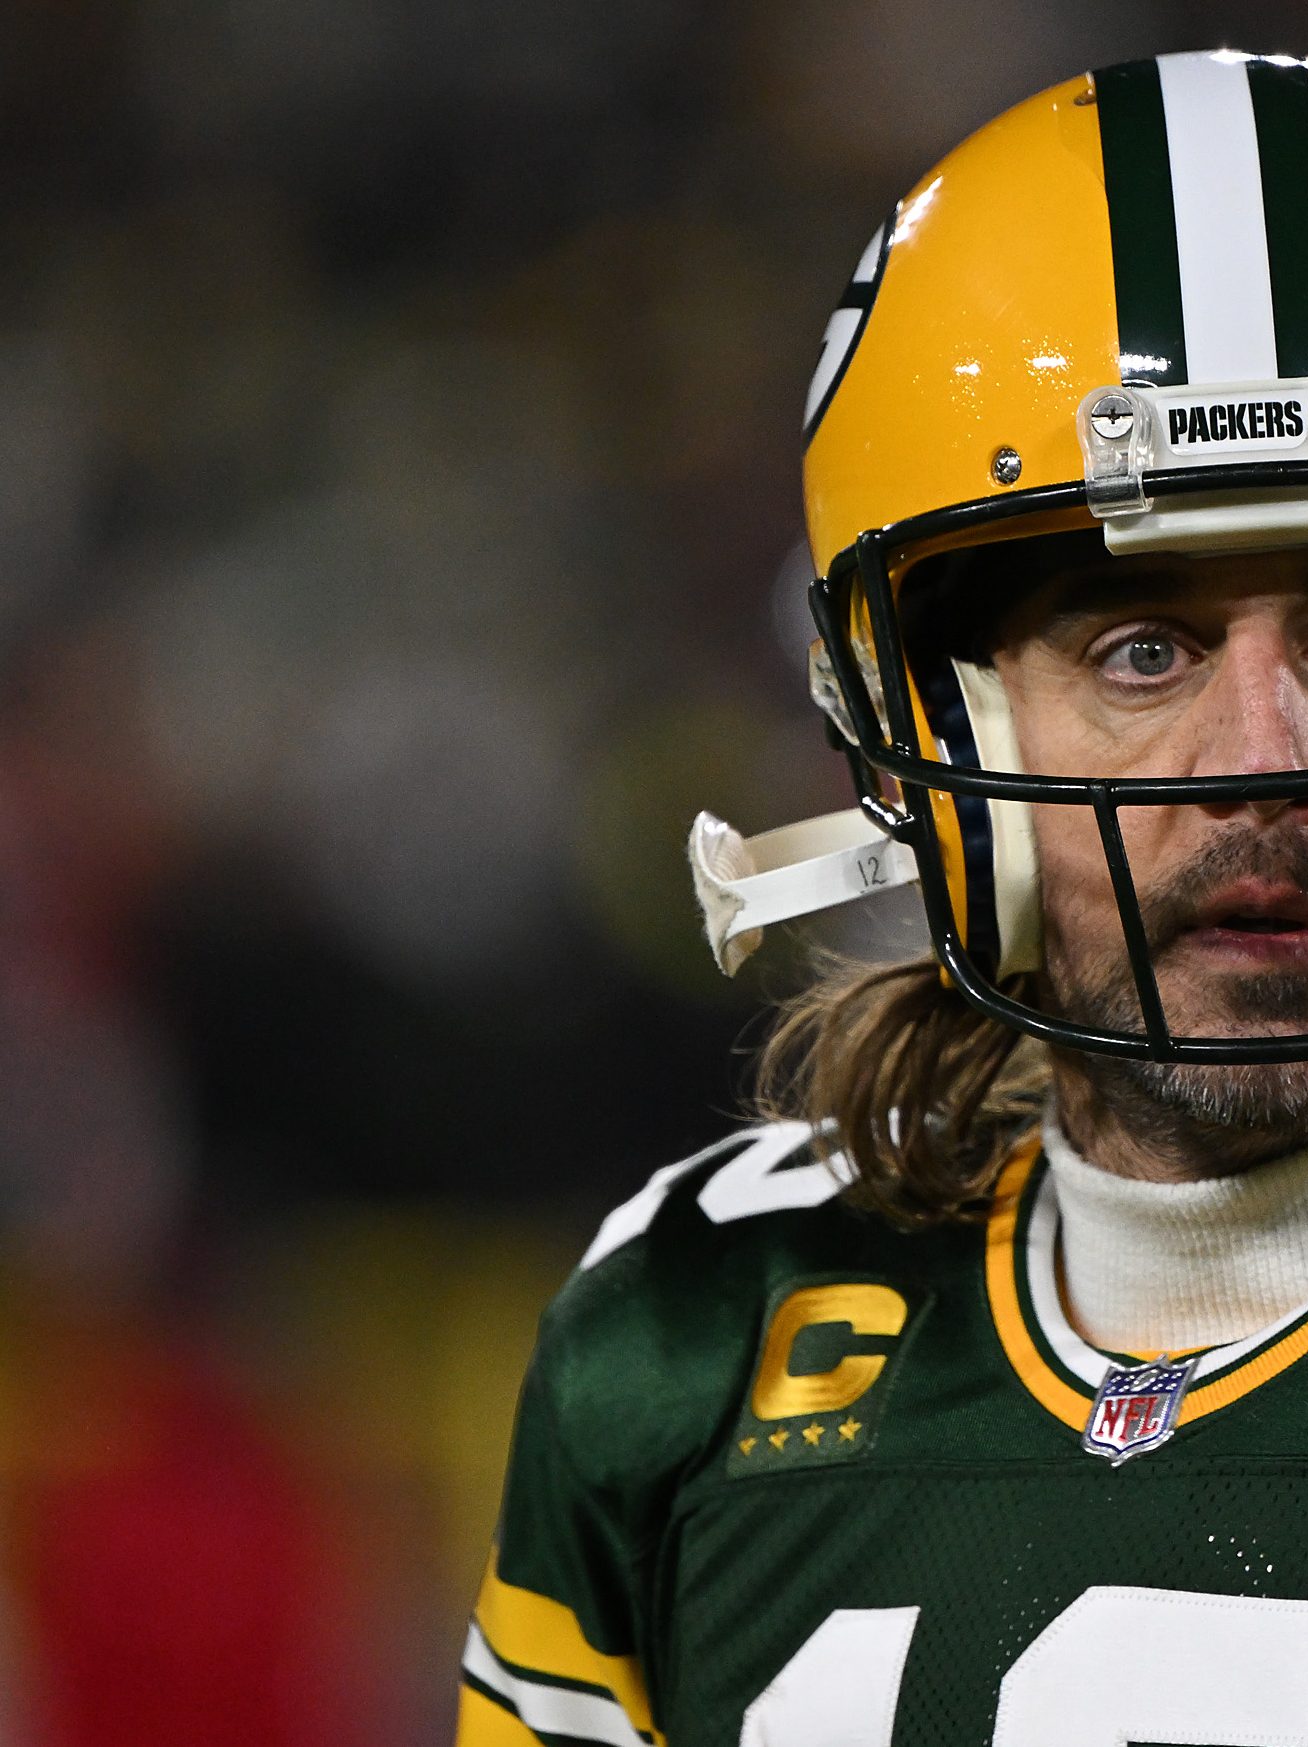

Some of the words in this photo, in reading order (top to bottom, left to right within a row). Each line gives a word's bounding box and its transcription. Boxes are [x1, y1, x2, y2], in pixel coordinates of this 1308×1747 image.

[1168, 400, 1303, 445] PACKERS
[857, 856, 887, 887] 12
[751, 1283, 908, 1422] C
[1095, 1396, 1160, 1443] NFL
